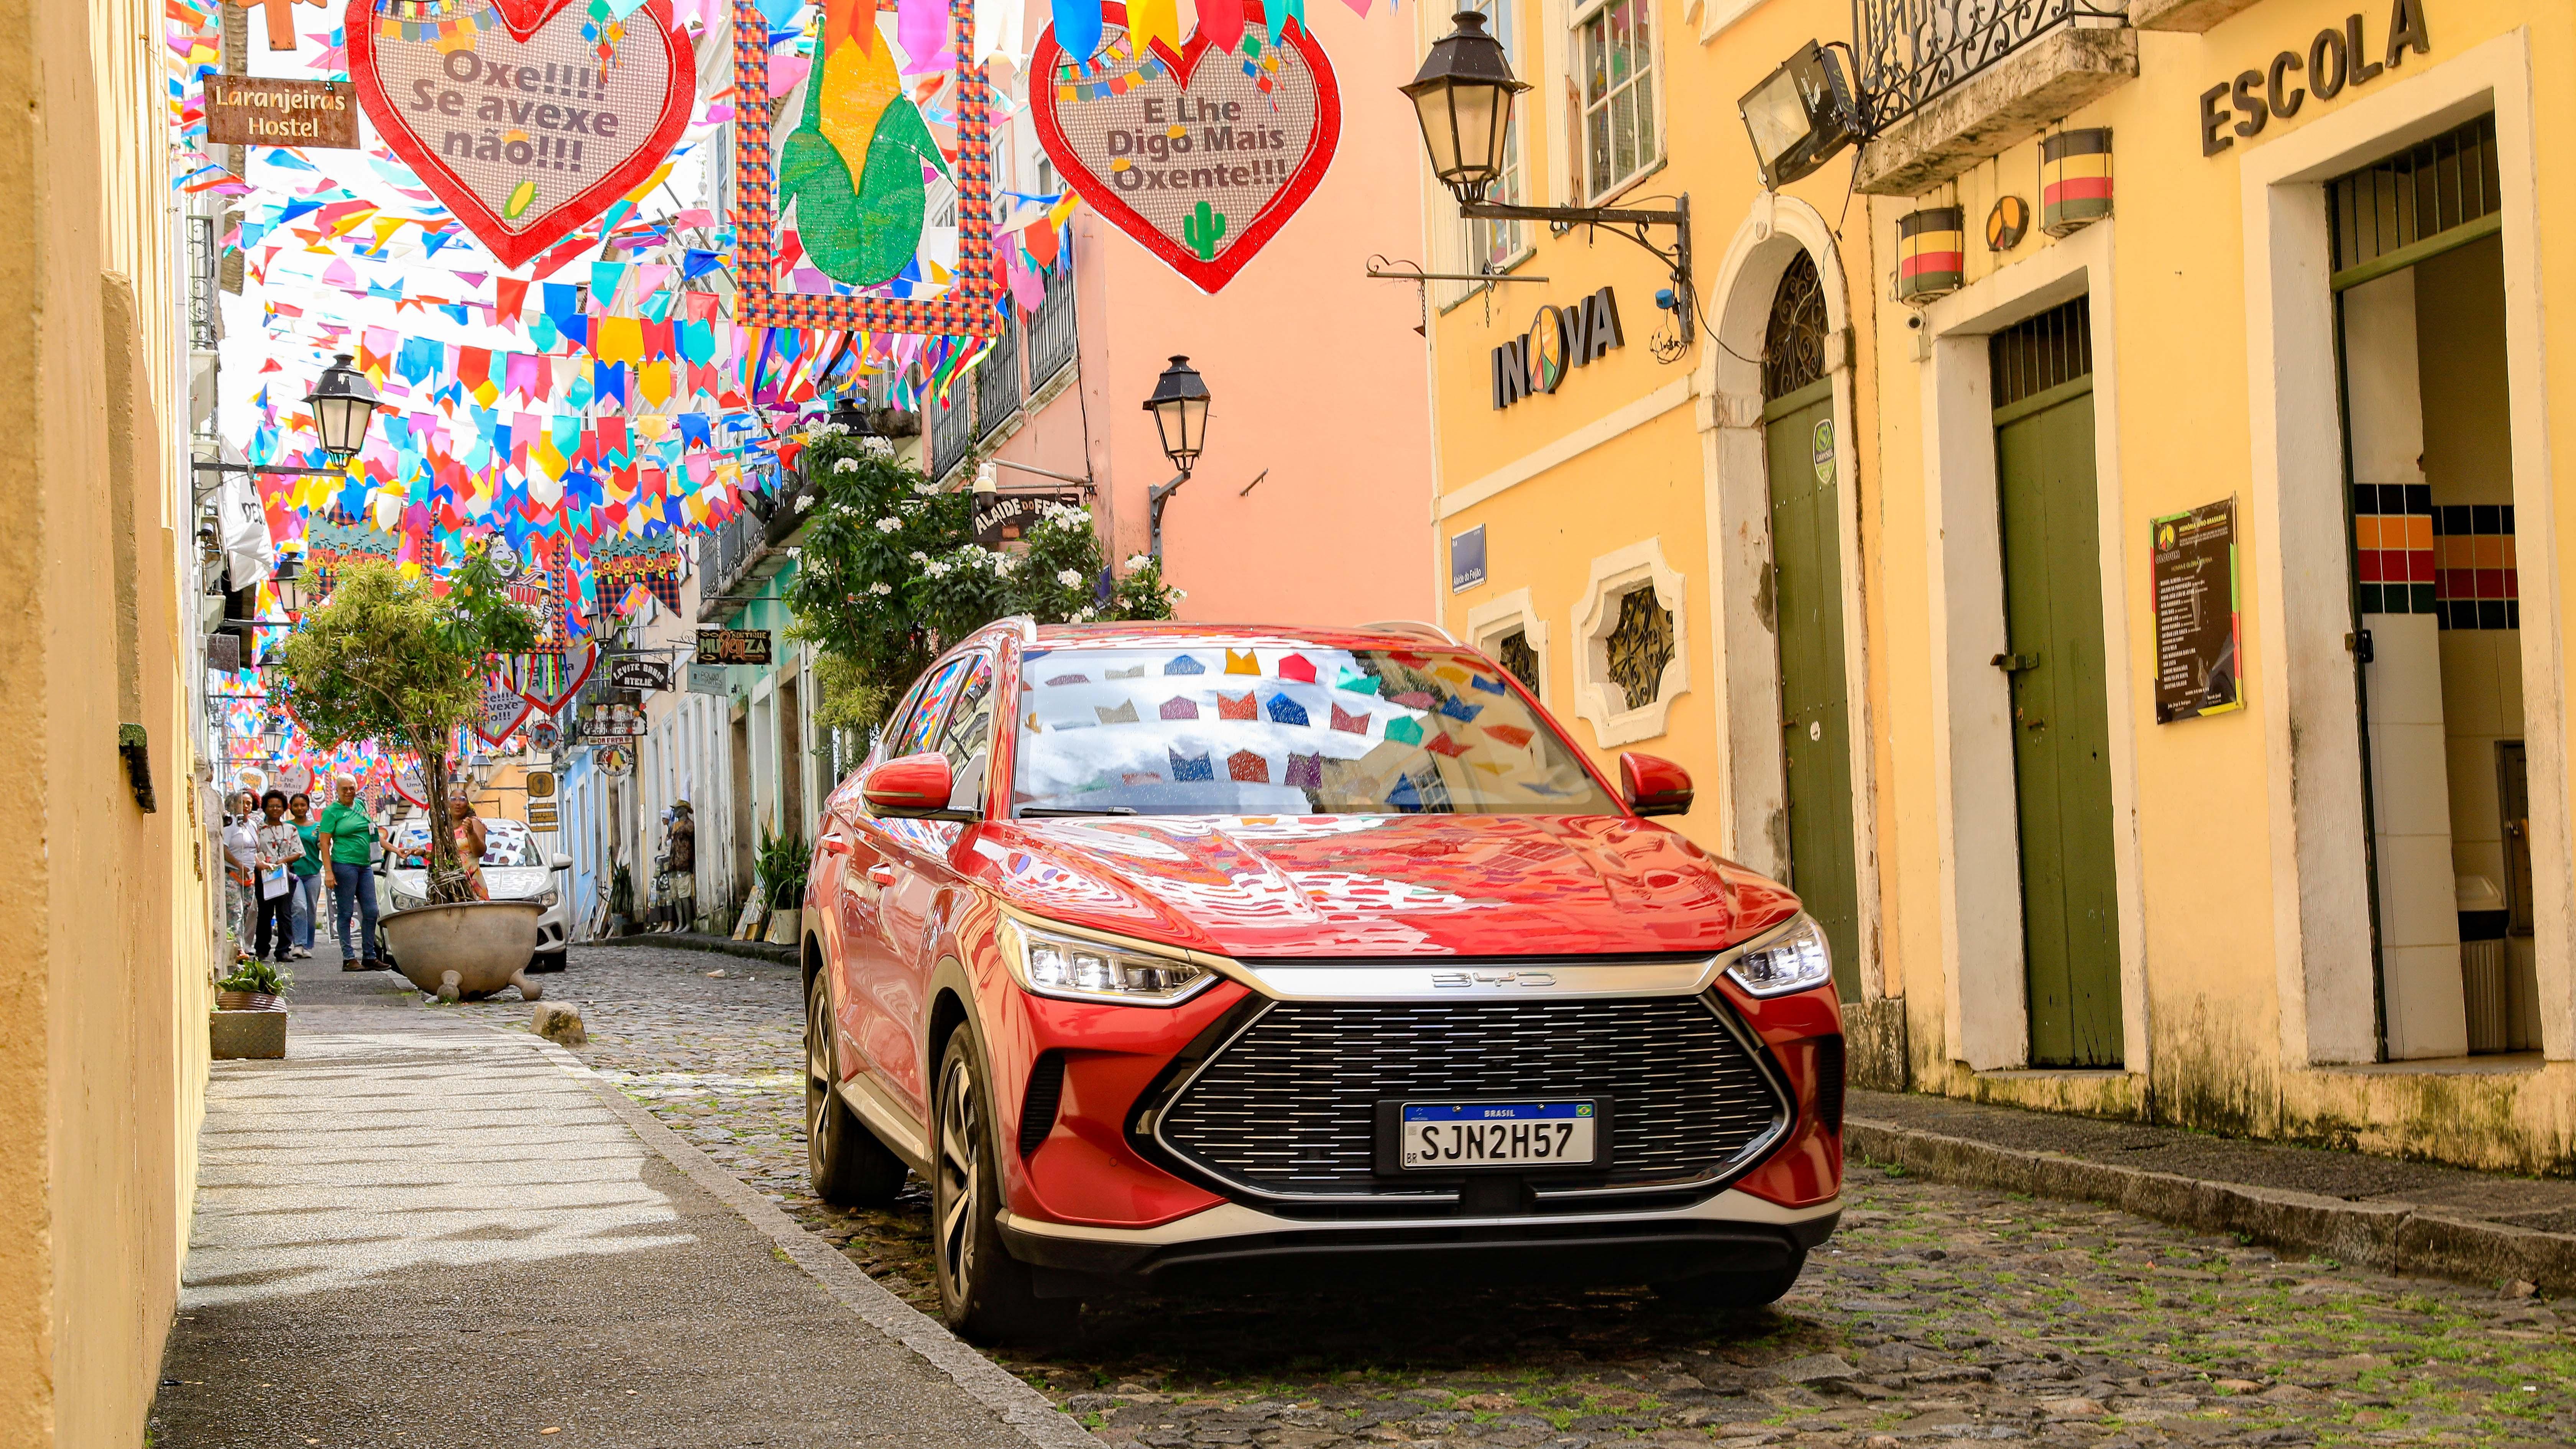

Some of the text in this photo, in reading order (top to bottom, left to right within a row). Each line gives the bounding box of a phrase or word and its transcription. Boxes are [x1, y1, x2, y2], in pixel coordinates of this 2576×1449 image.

[443, 49, 607, 101] Oxe!!!!
[2200, 0, 2430, 157] ESCOLA
[215, 85, 346, 114] Laranjeiras
[411, 79, 618, 137] Se avexe
[1144, 97, 1242, 123] E Lhe
[248, 117, 319, 137] Hostel
[442, 127, 583, 172] não!!!
[1107, 124, 1285, 163] Digo Mais
[1114, 159, 1286, 191] Oxente!!!
[975, 498, 1023, 536] ALAIDE
[1021, 500, 1035, 511] DO
[2155, 549, 2180, 565] OLODUM
[1464, 571, 1470, 582] do
[613, 663, 640, 680] LEVITE
[490, 702, 518, 711] vexe
[1431, 971, 1557, 988] BYD
[1484, 1109, 1515, 1117] BRASIL
[1421, 1123, 1574, 1160] SJN2H57
[1406, 1152, 1418, 1164] BR
